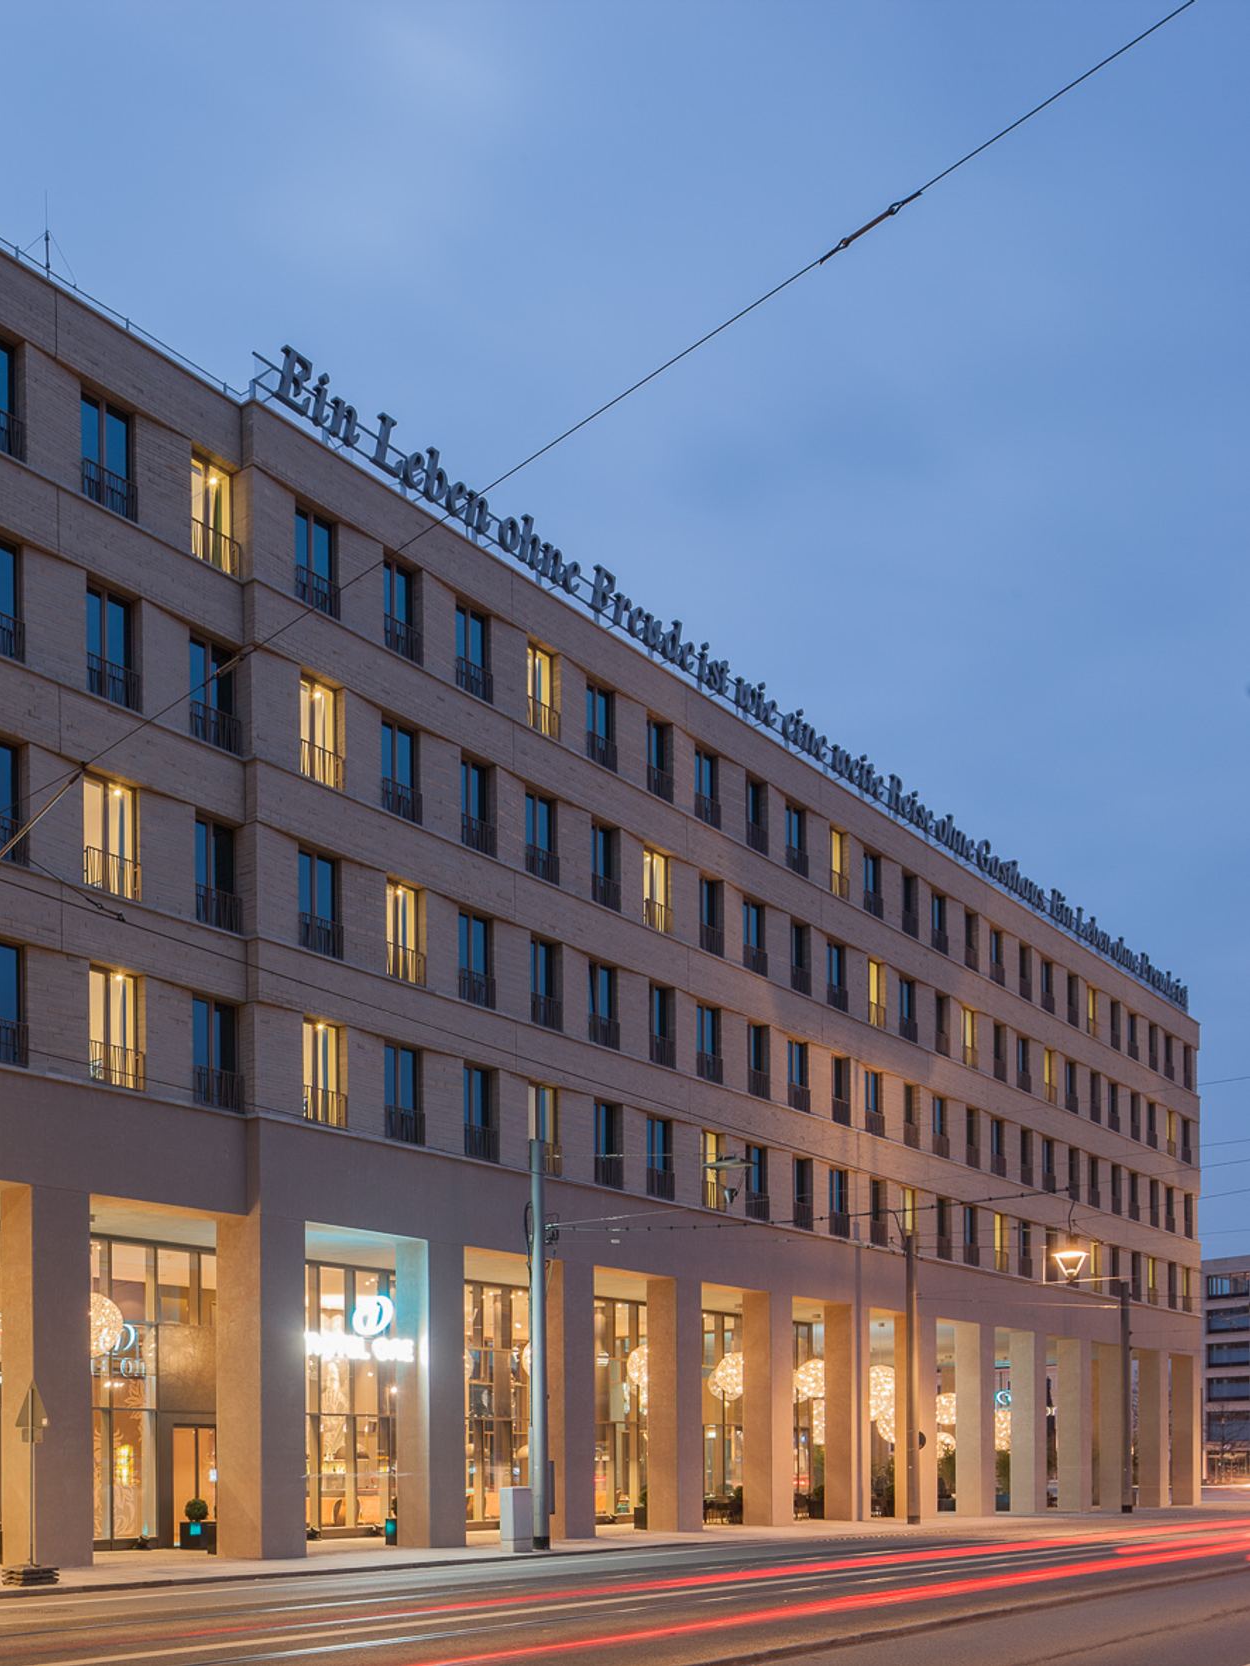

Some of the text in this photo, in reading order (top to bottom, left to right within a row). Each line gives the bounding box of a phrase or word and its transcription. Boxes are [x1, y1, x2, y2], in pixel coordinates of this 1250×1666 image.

[273, 344, 360, 447] Ein
[369, 411, 491, 535] Leben
[498, 513, 581, 594] ohne
[588, 563, 695, 671] Freude
[697, 641, 730, 696] ist
[735, 676, 777, 728] wie
[782, 709, 827, 761] eine
[830, 743, 884, 800] weite
[888, 773, 933, 834] Reise
[935, 813, 975, 861] ohne
[1049, 888, 1074, 930] Ein
[1075, 906, 1110, 957] Leben
